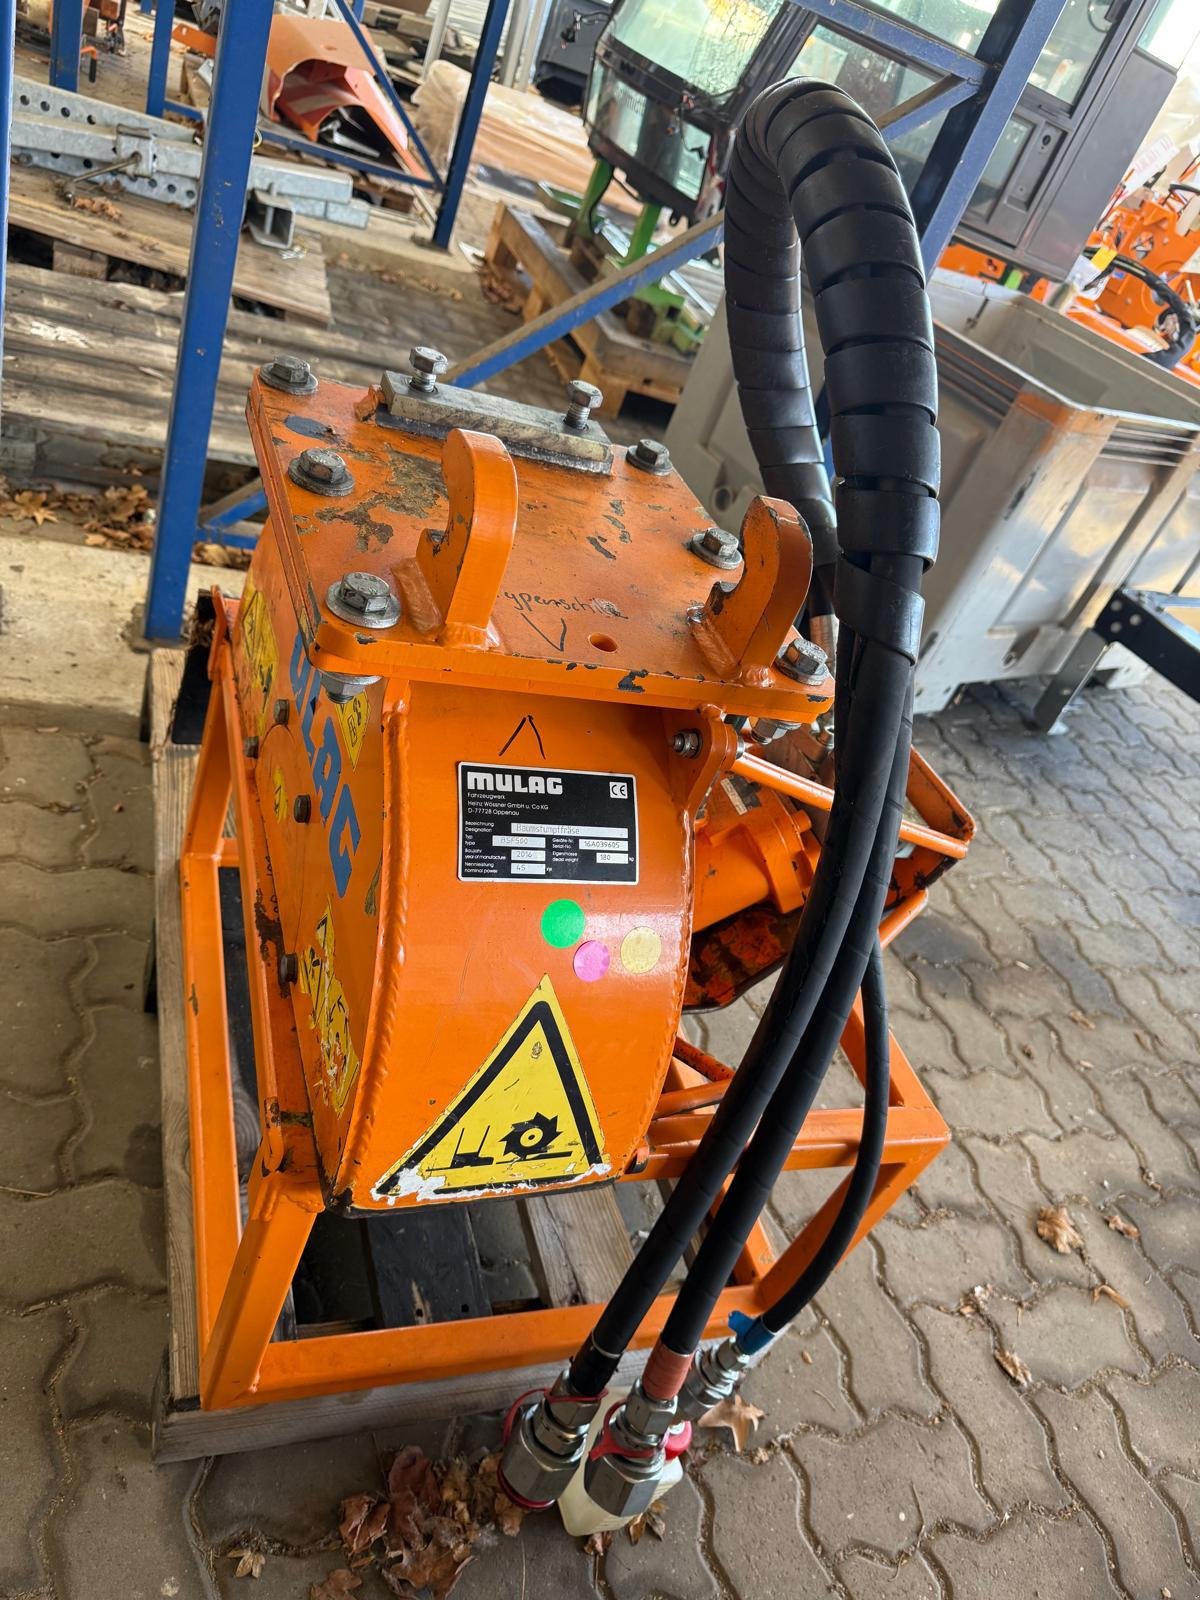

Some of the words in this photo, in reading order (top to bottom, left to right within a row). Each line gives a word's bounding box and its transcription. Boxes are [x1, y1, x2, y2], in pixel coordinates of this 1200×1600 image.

[290, 632, 361, 898] ULAG
[467, 771, 563, 794] MULAG
[516, 823, 580, 835] Baumstumpffräse
